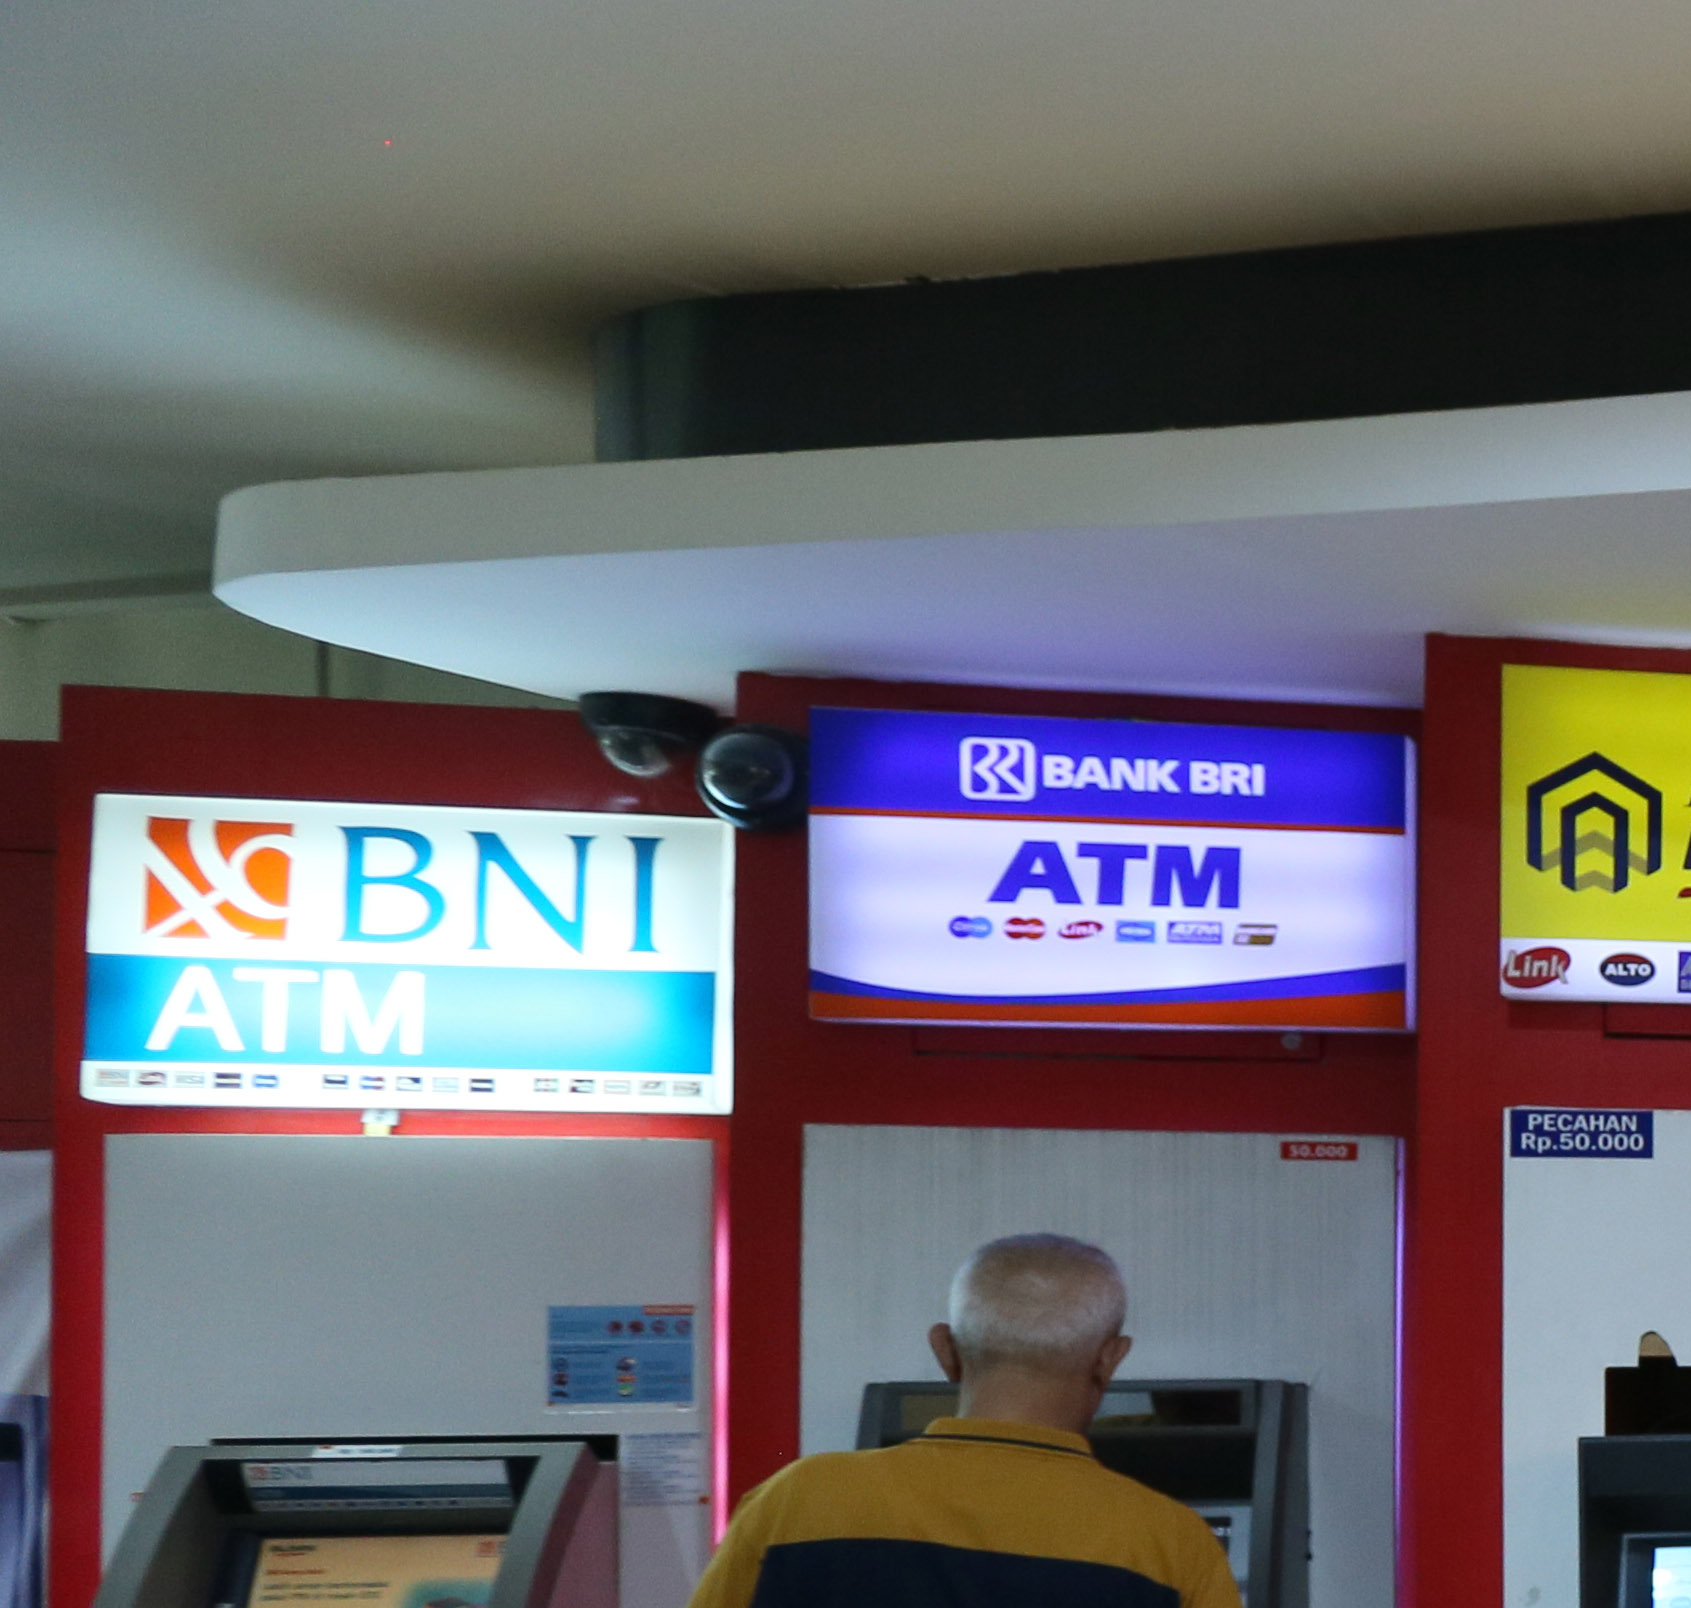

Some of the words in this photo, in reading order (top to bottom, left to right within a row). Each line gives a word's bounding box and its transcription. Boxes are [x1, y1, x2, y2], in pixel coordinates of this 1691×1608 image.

[1042, 755, 1180, 794] BANK
[1189, 761, 1265, 797] BRI
[339, 826, 664, 953] BNI
[987, 840, 1241, 909] ATM
[1503, 948, 1569, 985] Link
[1603, 961, 1651, 978] ALTO
[145, 965, 425, 1055] ATM
[1527, 1113, 1638, 1133] PECAHAN
[1520, 1132, 1645, 1156] Rp.50.000
